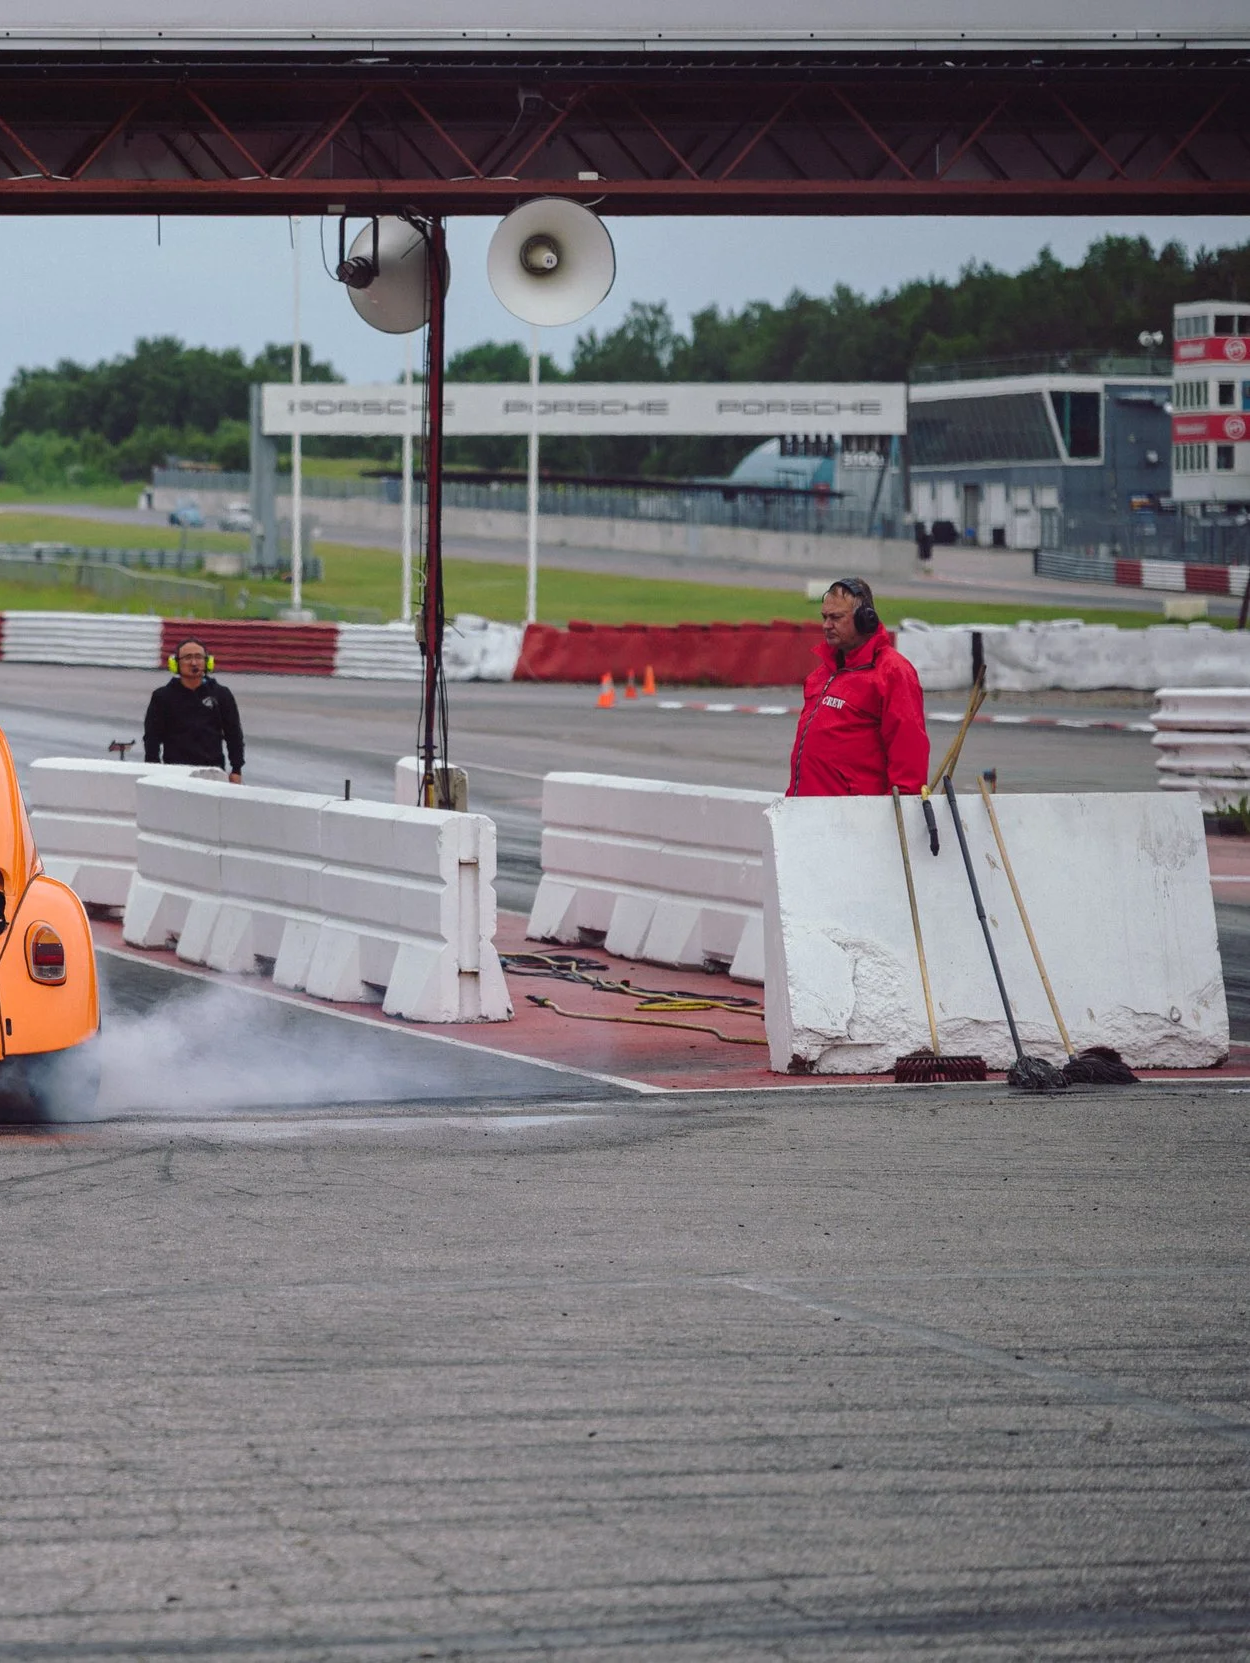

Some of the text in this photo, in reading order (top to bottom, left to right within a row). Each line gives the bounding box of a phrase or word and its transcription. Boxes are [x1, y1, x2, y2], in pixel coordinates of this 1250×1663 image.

[288, 400, 455, 416] PORSCE
[503, 400, 670, 416] PORSCHE
[717, 400, 882, 416] PORSCHE
[822, 696, 846, 709] CREW
